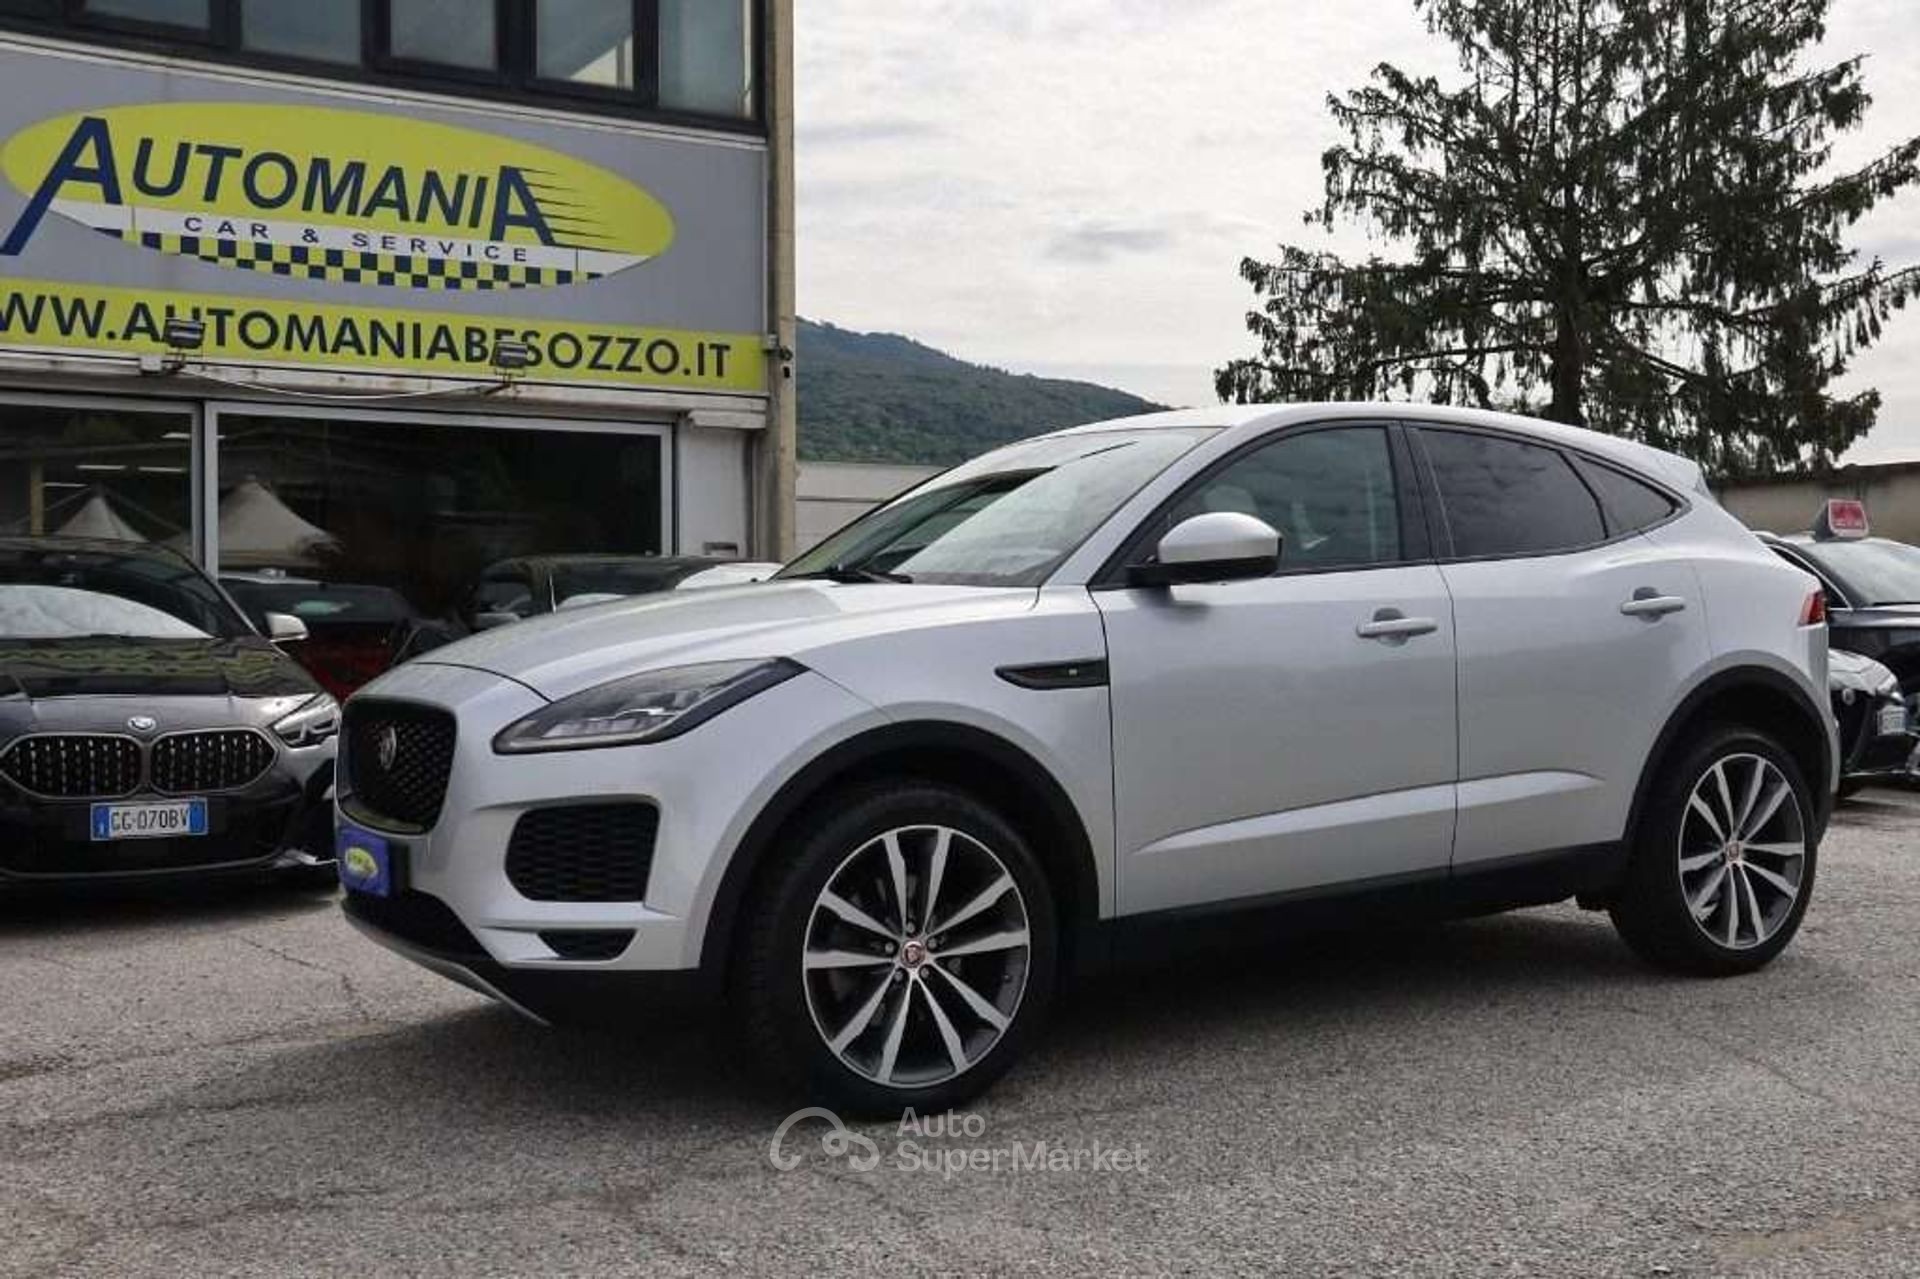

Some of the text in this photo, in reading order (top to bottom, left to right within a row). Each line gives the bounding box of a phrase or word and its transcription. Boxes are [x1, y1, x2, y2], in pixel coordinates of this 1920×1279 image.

[0, 116, 558, 256] AUTOMANIA
[184, 216, 527, 262] CAR & SERVICE
